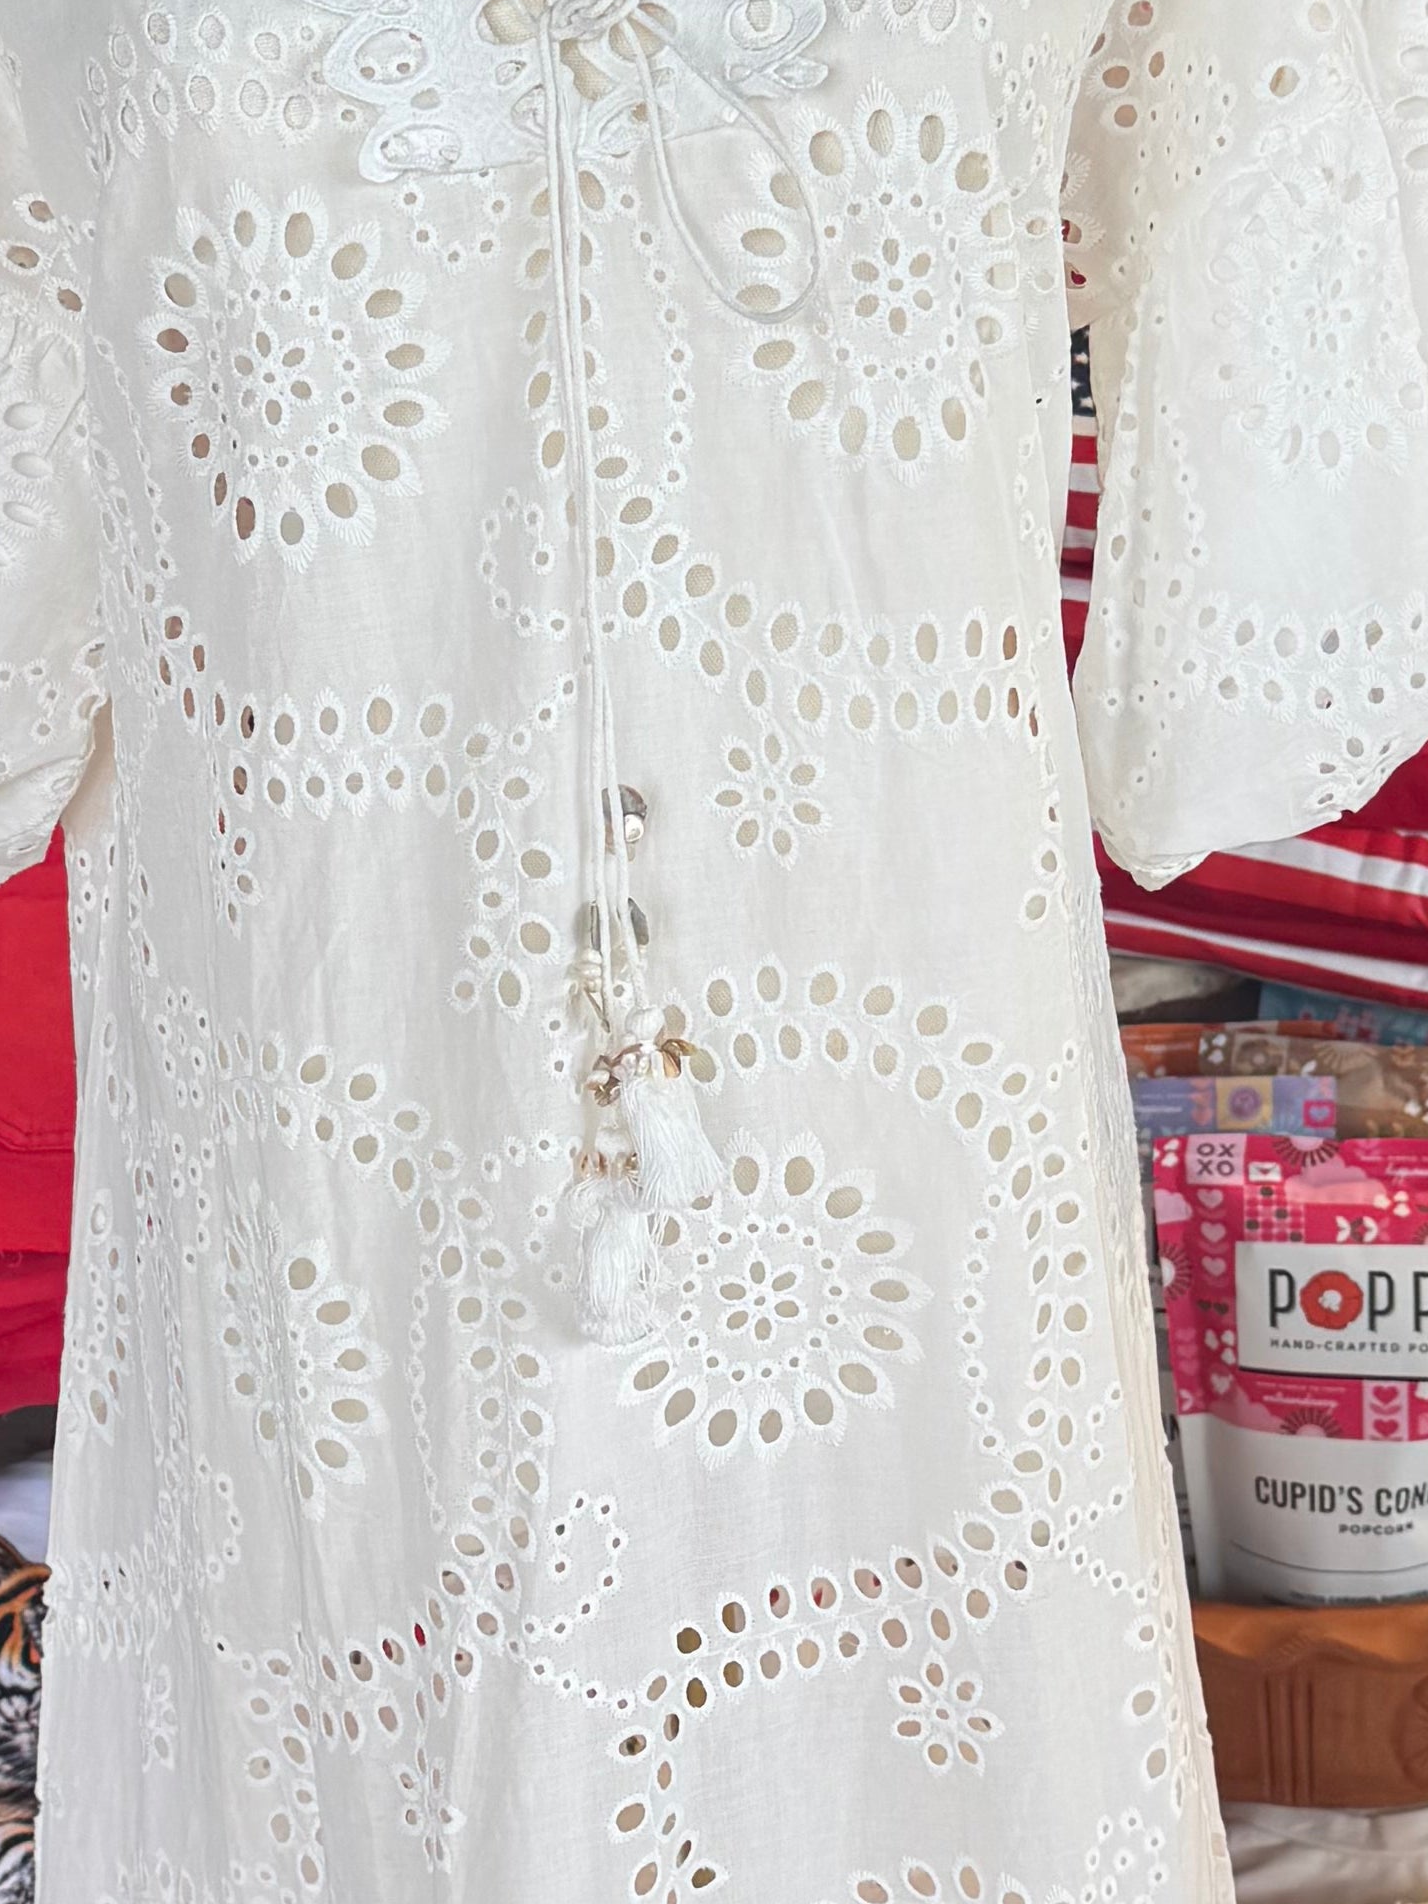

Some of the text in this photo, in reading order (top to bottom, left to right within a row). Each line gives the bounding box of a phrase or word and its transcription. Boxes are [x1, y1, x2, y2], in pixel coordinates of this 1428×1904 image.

[1269, 1339, 1400, 1353] HAND-CRAFTED
[1254, 1475, 1363, 1516] CUPID'S
[1338, 1521, 1414, 1536] POPCORN
